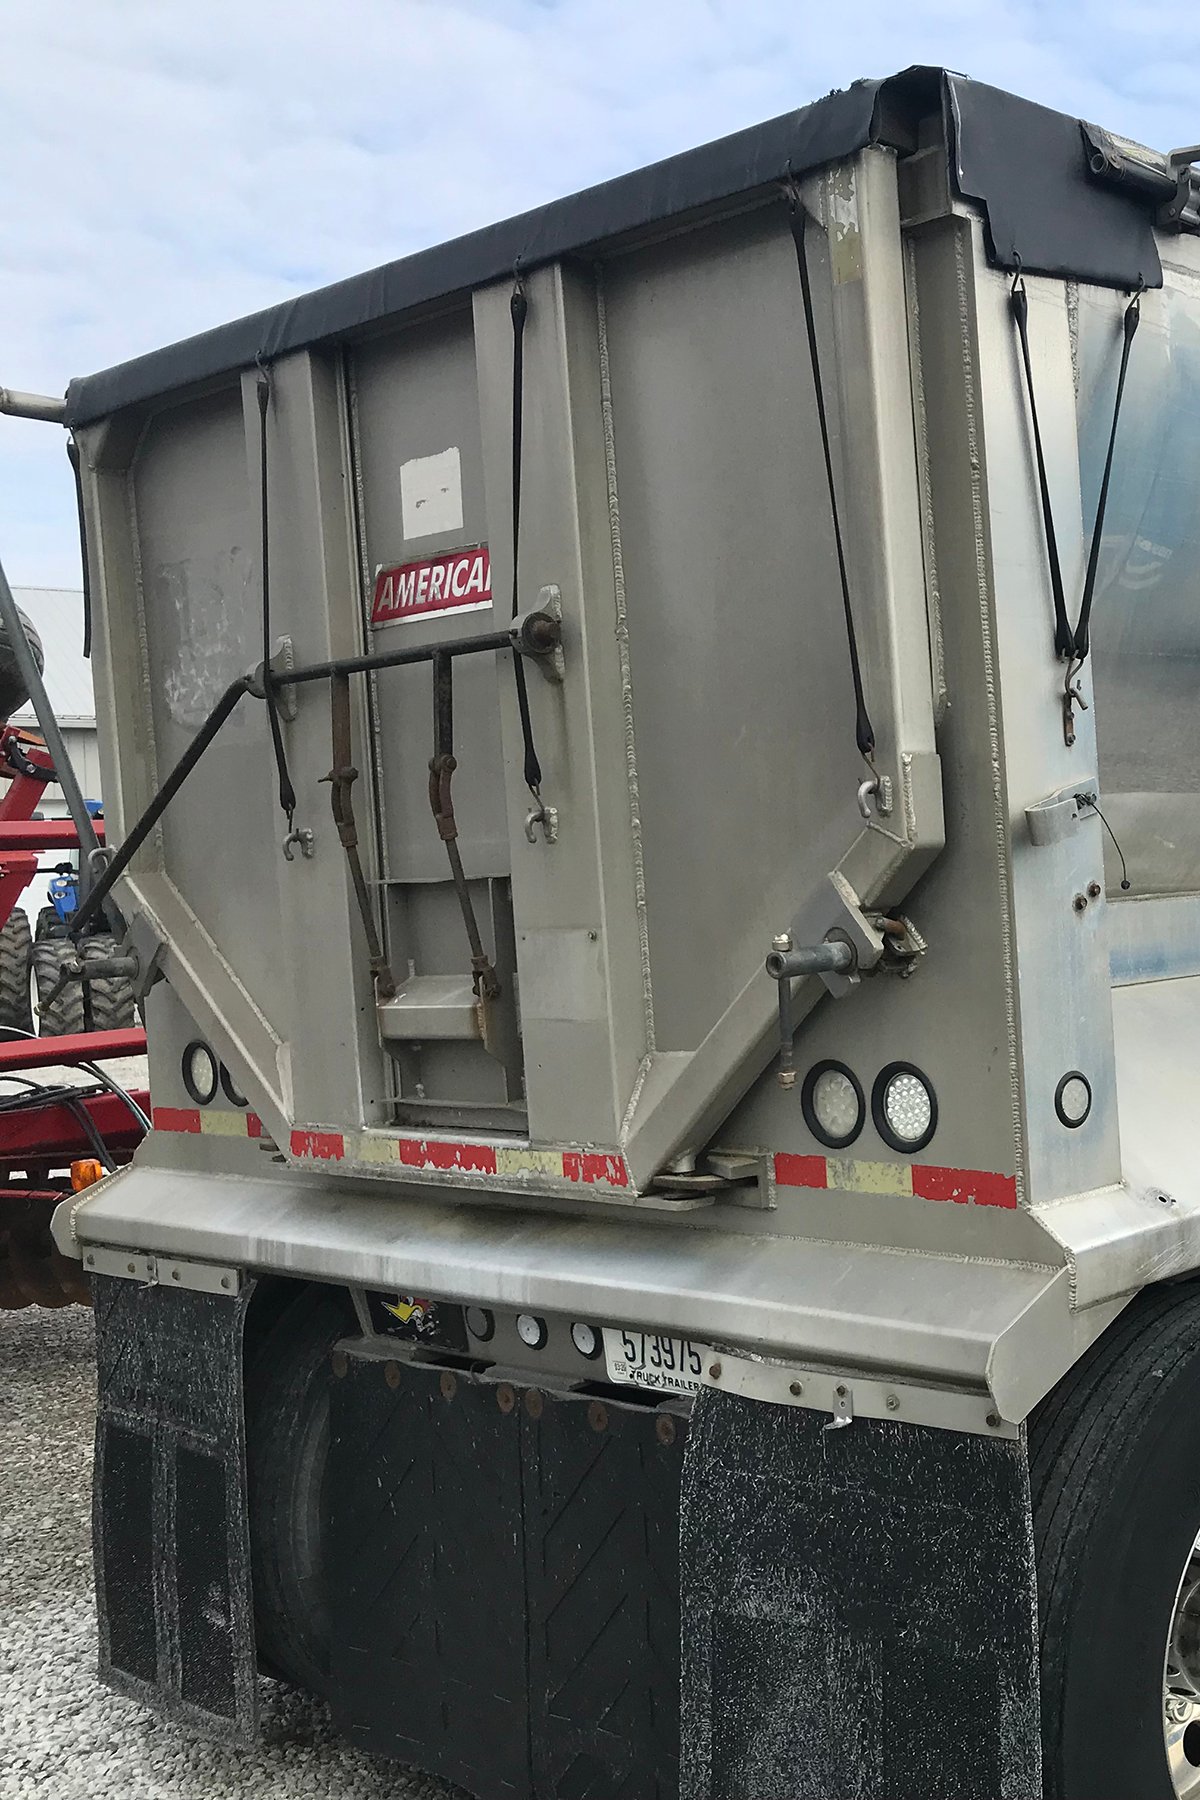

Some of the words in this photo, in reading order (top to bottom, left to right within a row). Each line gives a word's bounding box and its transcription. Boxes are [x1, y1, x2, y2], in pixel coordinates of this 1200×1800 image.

[377, 556, 492, 612] AMERICA
[622, 1331, 702, 1375] 573975
[663, 1376, 699, 1391] TRAILER
